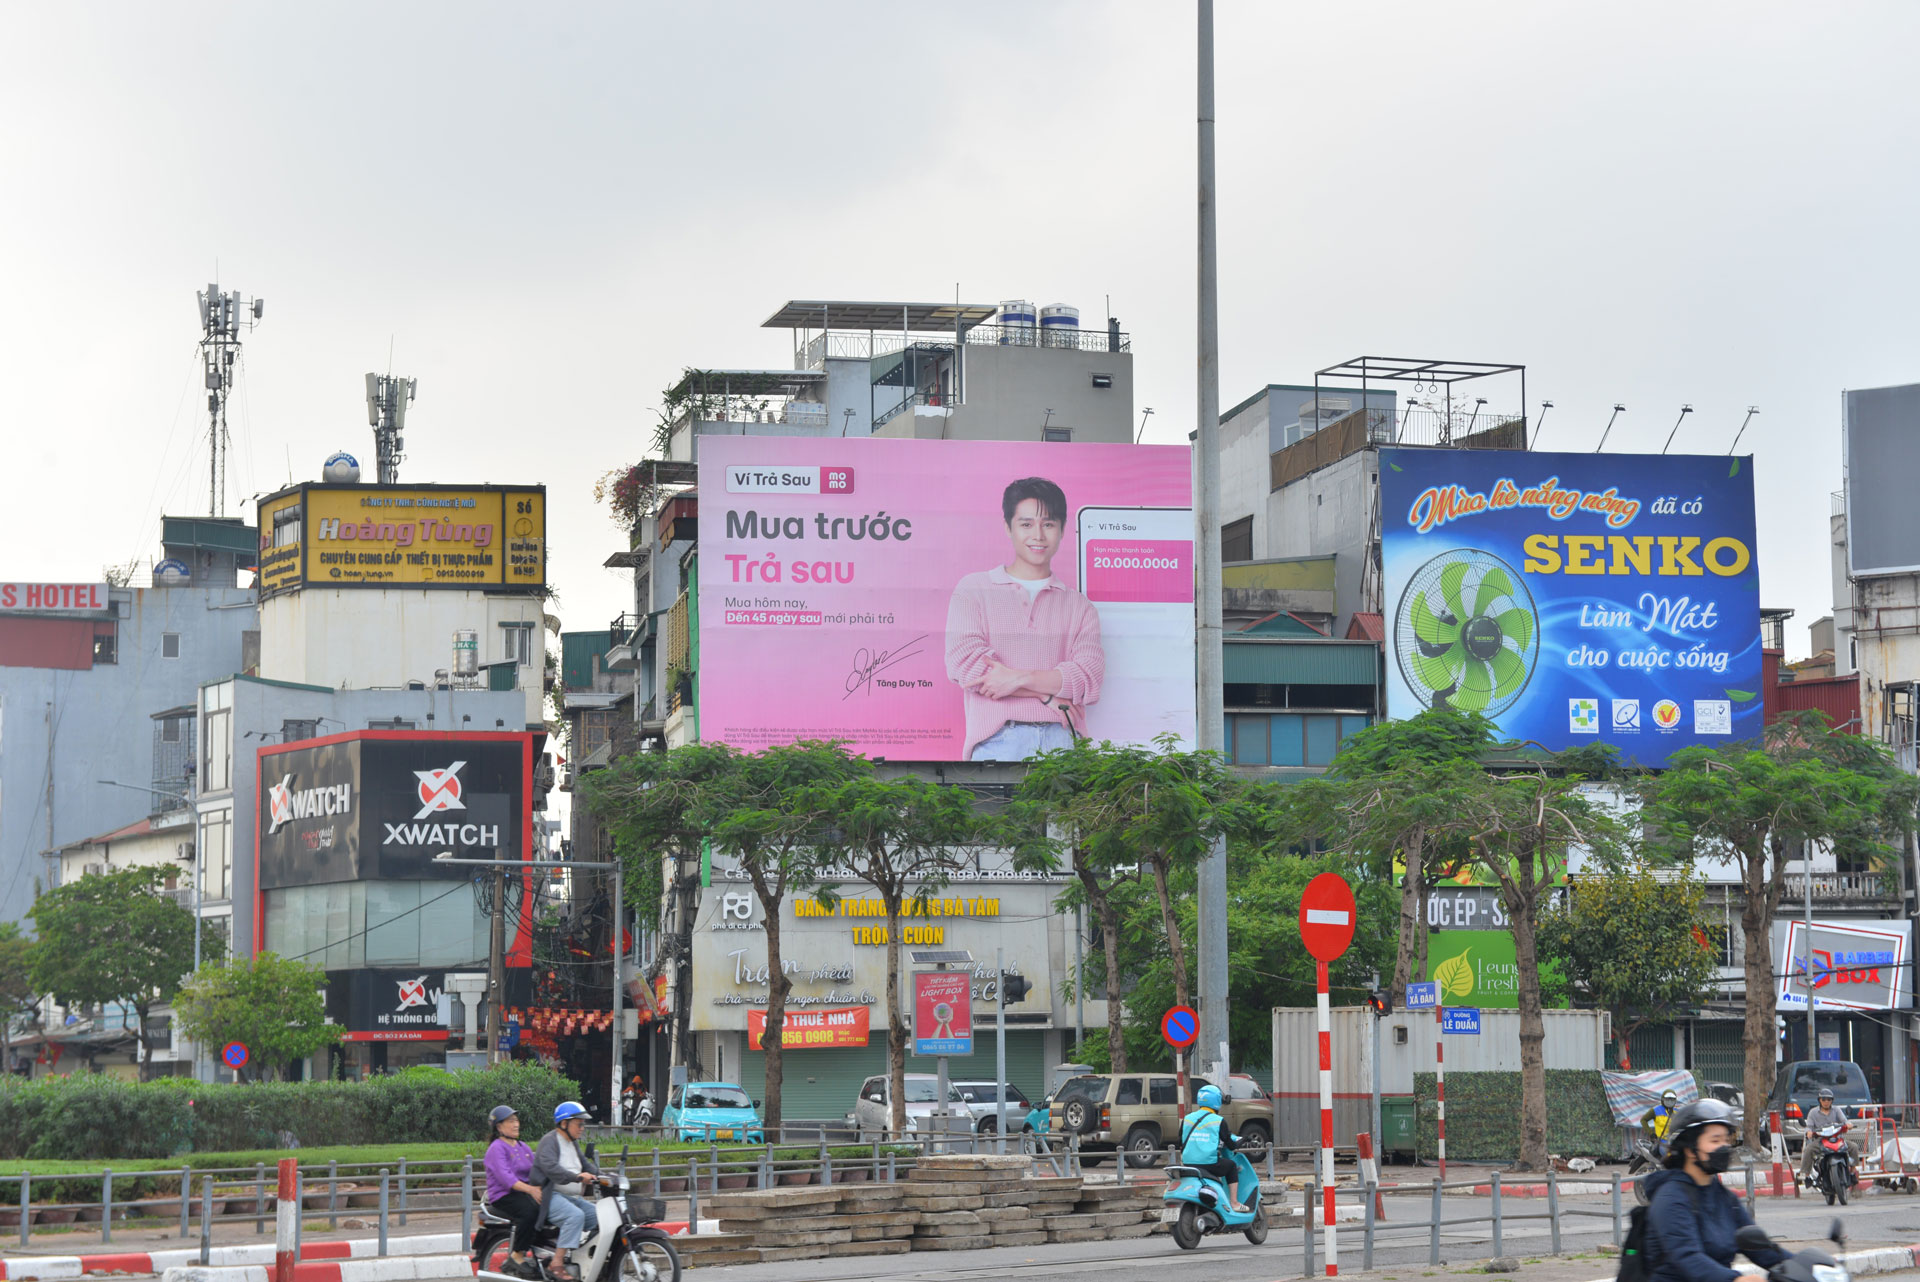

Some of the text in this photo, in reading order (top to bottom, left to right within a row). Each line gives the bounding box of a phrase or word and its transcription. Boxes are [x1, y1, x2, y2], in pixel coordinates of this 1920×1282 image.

[735, 471, 811, 487] Ví Trả Sau
[383, 498, 393, 507] TY
[416, 496, 438, 507] CÔNG
[1409, 476, 1703, 532] Mùa hè nắng nóng đã có
[318, 515, 494, 548] Hoàng Tùng
[726, 509, 912, 541] Mua trước
[1099, 522, 1137, 532] Ví Trả Sau
[320, 547, 493, 568] CHUYÊN CUNG CẤP THIẾT BỊ THỰC PHẨM
[1093, 556, 1179, 570] 20.000.000đ
[1523, 533, 1751, 577] SENKO
[343, 569, 394, 579] hoantung.vn
[724, 551, 855, 584] Trả sau
[26, 584, 102, 609] HOTEL
[724, 596, 808, 611] Mua hôm nay,
[726, 612, 895, 626] Đến 45 ngày sau mới phải trả
[1580, 592, 1718, 635] Làm Mát
[1566, 643, 1730, 673] cho cuộc sống
[898, 679, 918, 689] Duy
[918, 678, 933, 688] Tân
[382, 822, 499, 847] XWATCH
[840, 896, 888, 917] TRÁNG
[943, 896, 965, 916] BÀ
[1454, 891, 1477, 926] ÉP
[852, 923, 945, 948] TRỘN CUỘN
[1833, 951, 1895, 965] BARBER
[1836, 966, 1881, 984] BOX
[920, 988, 946, 998] LIGHT
[945, 986, 964, 995] BOX
[1409, 992, 1434, 1005] XÃ ĐÀN
[378, 1013, 391, 1025] HỆ
[392, 1012, 422, 1024] THỐNG
[791, 1012, 824, 1027] THUÊ
[828, 1011, 856, 1026] NHÀ
[1444, 1017, 1478, 1030] LÊ DUẨN
[805, 1029, 834, 1043] 0908
